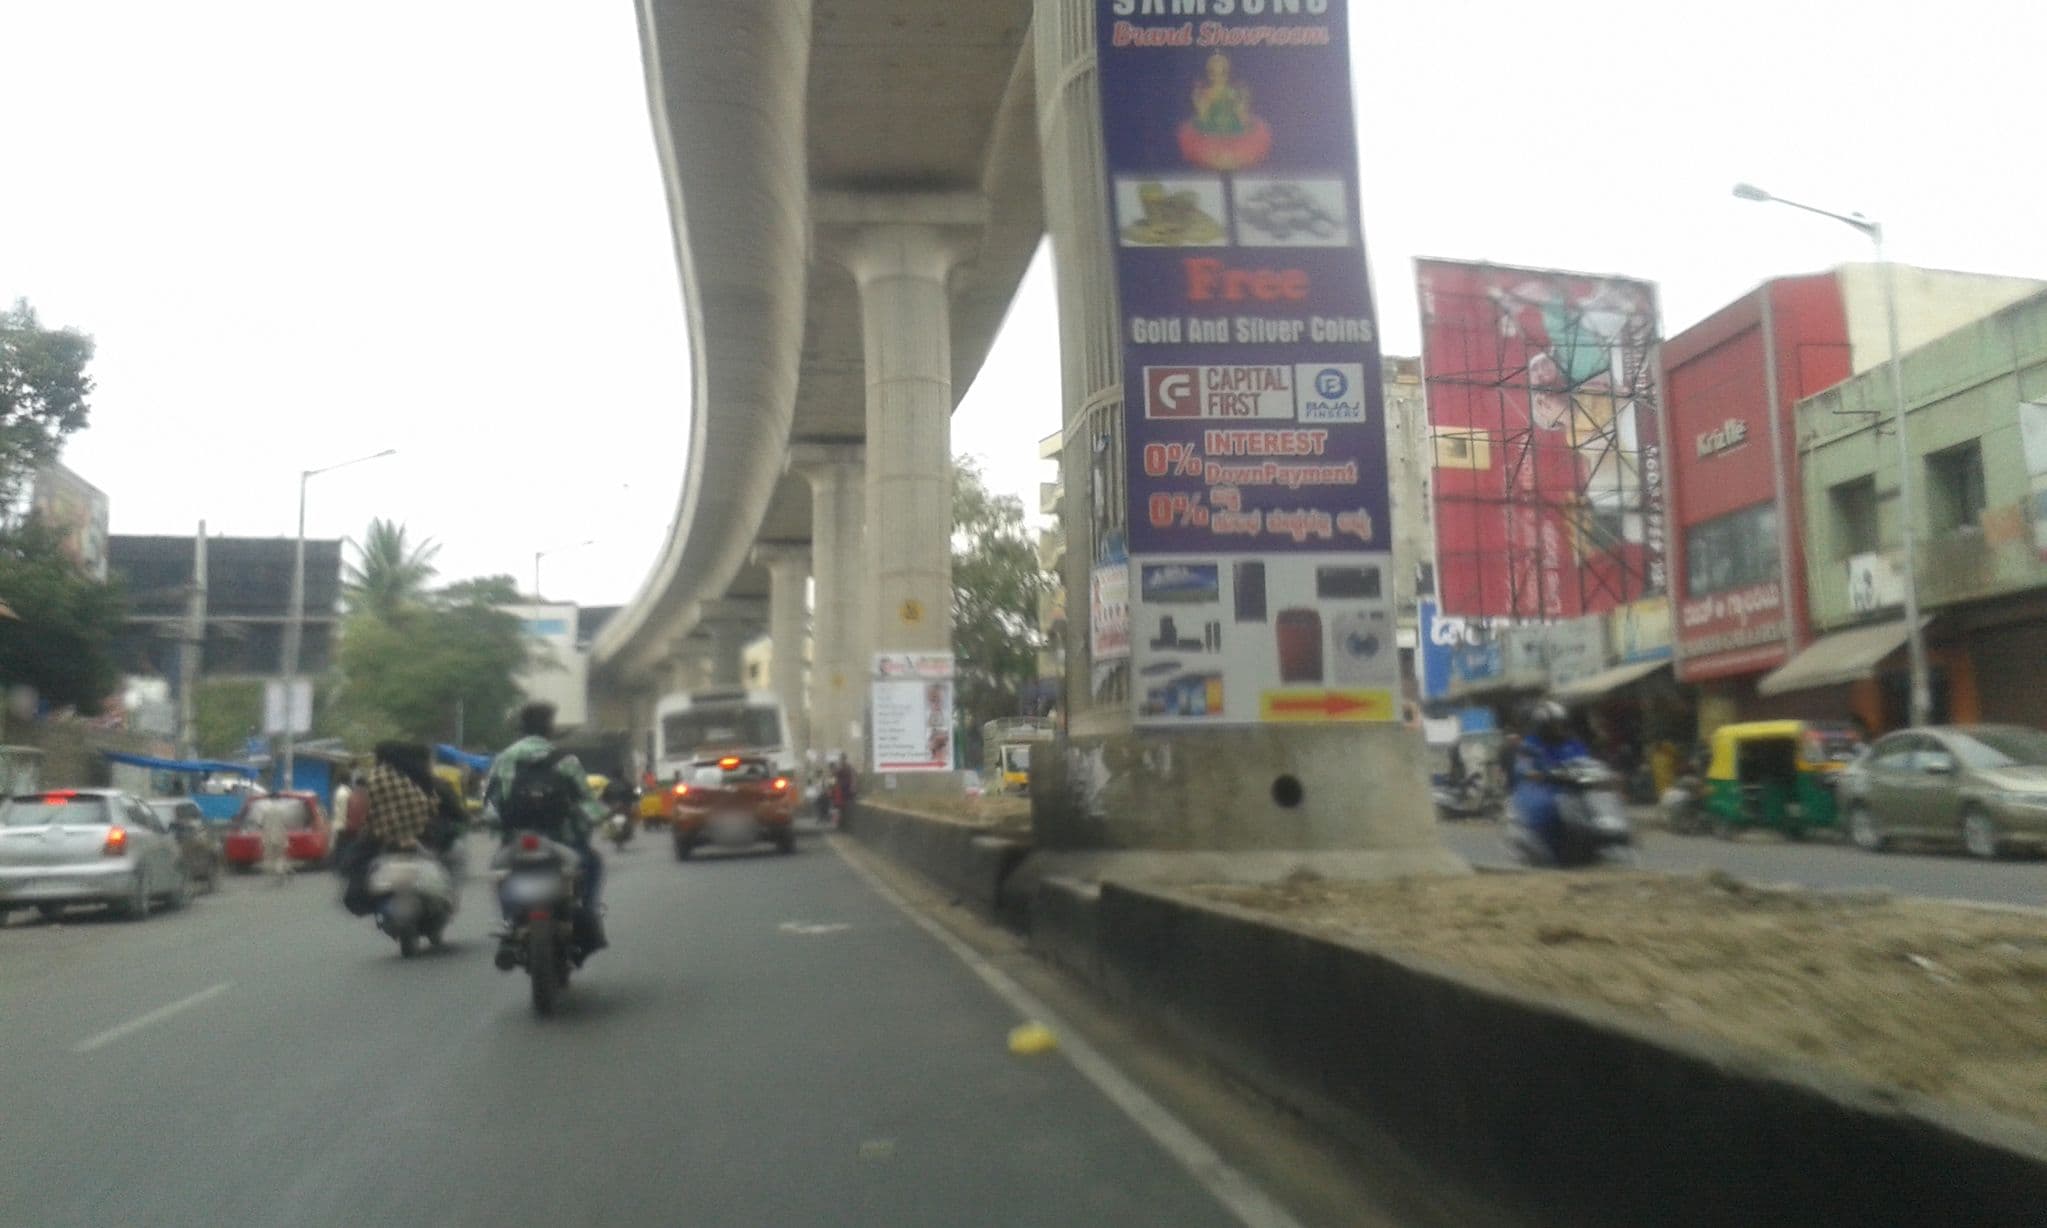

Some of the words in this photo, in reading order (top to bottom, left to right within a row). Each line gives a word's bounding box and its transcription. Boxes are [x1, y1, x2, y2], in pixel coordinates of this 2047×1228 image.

[1112, 21, 1192, 47] Brand
[1198, 20, 1330, 48] Showroom
[1183, 257, 1310, 302] Free
[1132, 316, 1182, 344] Gold
[1188, 316, 1229, 344] And
[1236, 315, 1305, 344] Silver
[1311, 315, 1373, 344] Coins
[1206, 367, 1289, 392] CAPITAL
[1207, 393, 1261, 417] FIRST
[1305, 402, 1361, 411] BAJAJ
[1205, 430, 1328, 455] INTEREST
[1144, 443, 1203, 477] 0%
[1149, 492, 1209, 529] 0%
